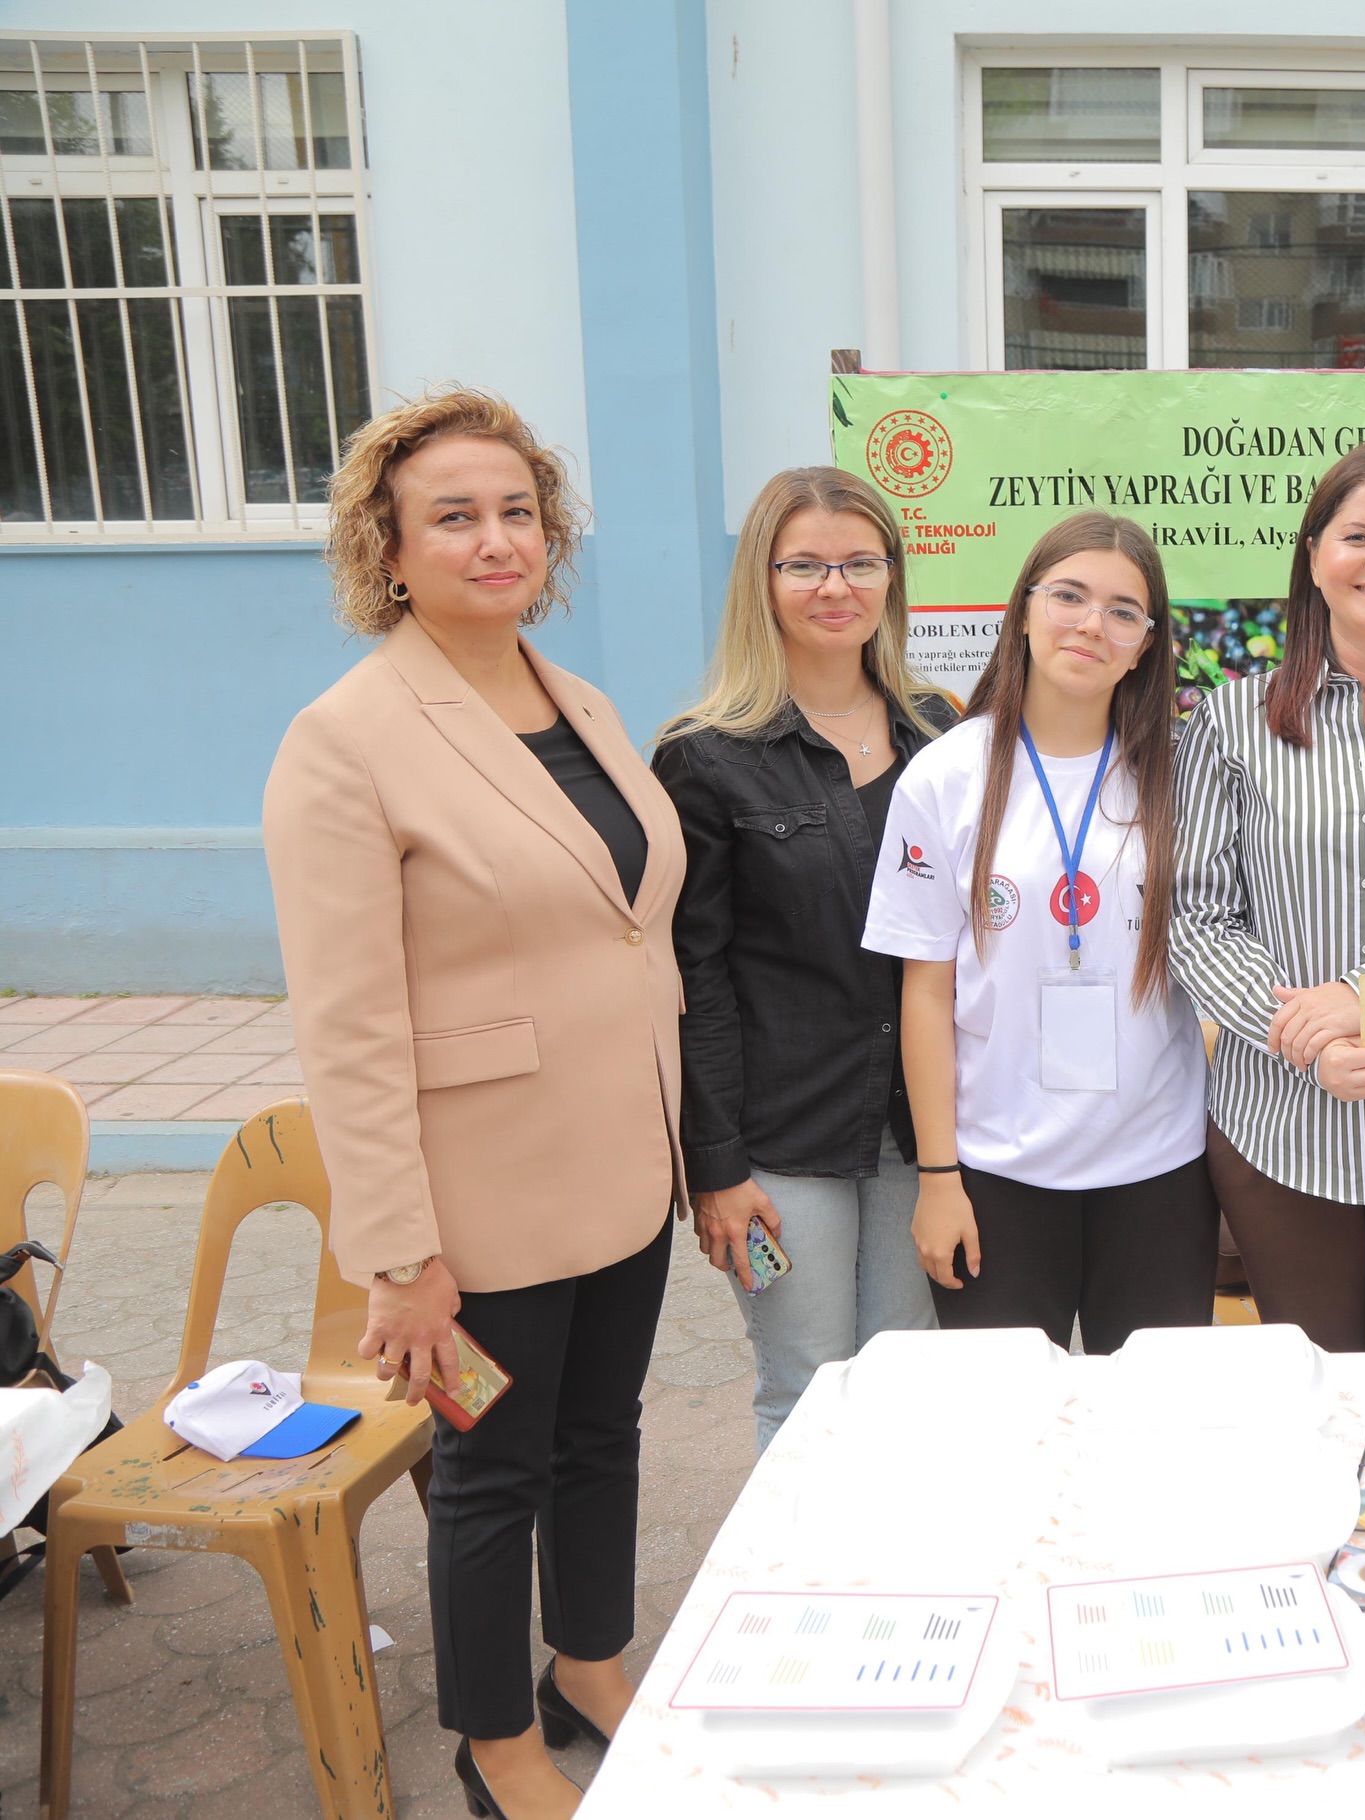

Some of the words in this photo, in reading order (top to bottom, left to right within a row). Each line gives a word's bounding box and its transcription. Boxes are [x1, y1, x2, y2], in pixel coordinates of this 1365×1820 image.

[1183, 417, 1326, 457] DOĞADAN
[989, 467, 1096, 507] ZEYTİN
[1104, 465, 1232, 506] YAPRAĞI
[1240, 474, 1276, 505] VE
[901, 507, 927, 521] T.C.
[915, 522, 996, 538] TEKNOLOJİ
[1151, 522, 1245, 549] İRAVİL,
[903, 540, 956, 555] ANLIĞI
[918, 650, 956, 661] yaprağı
[934, 662, 966, 673] etkiler
